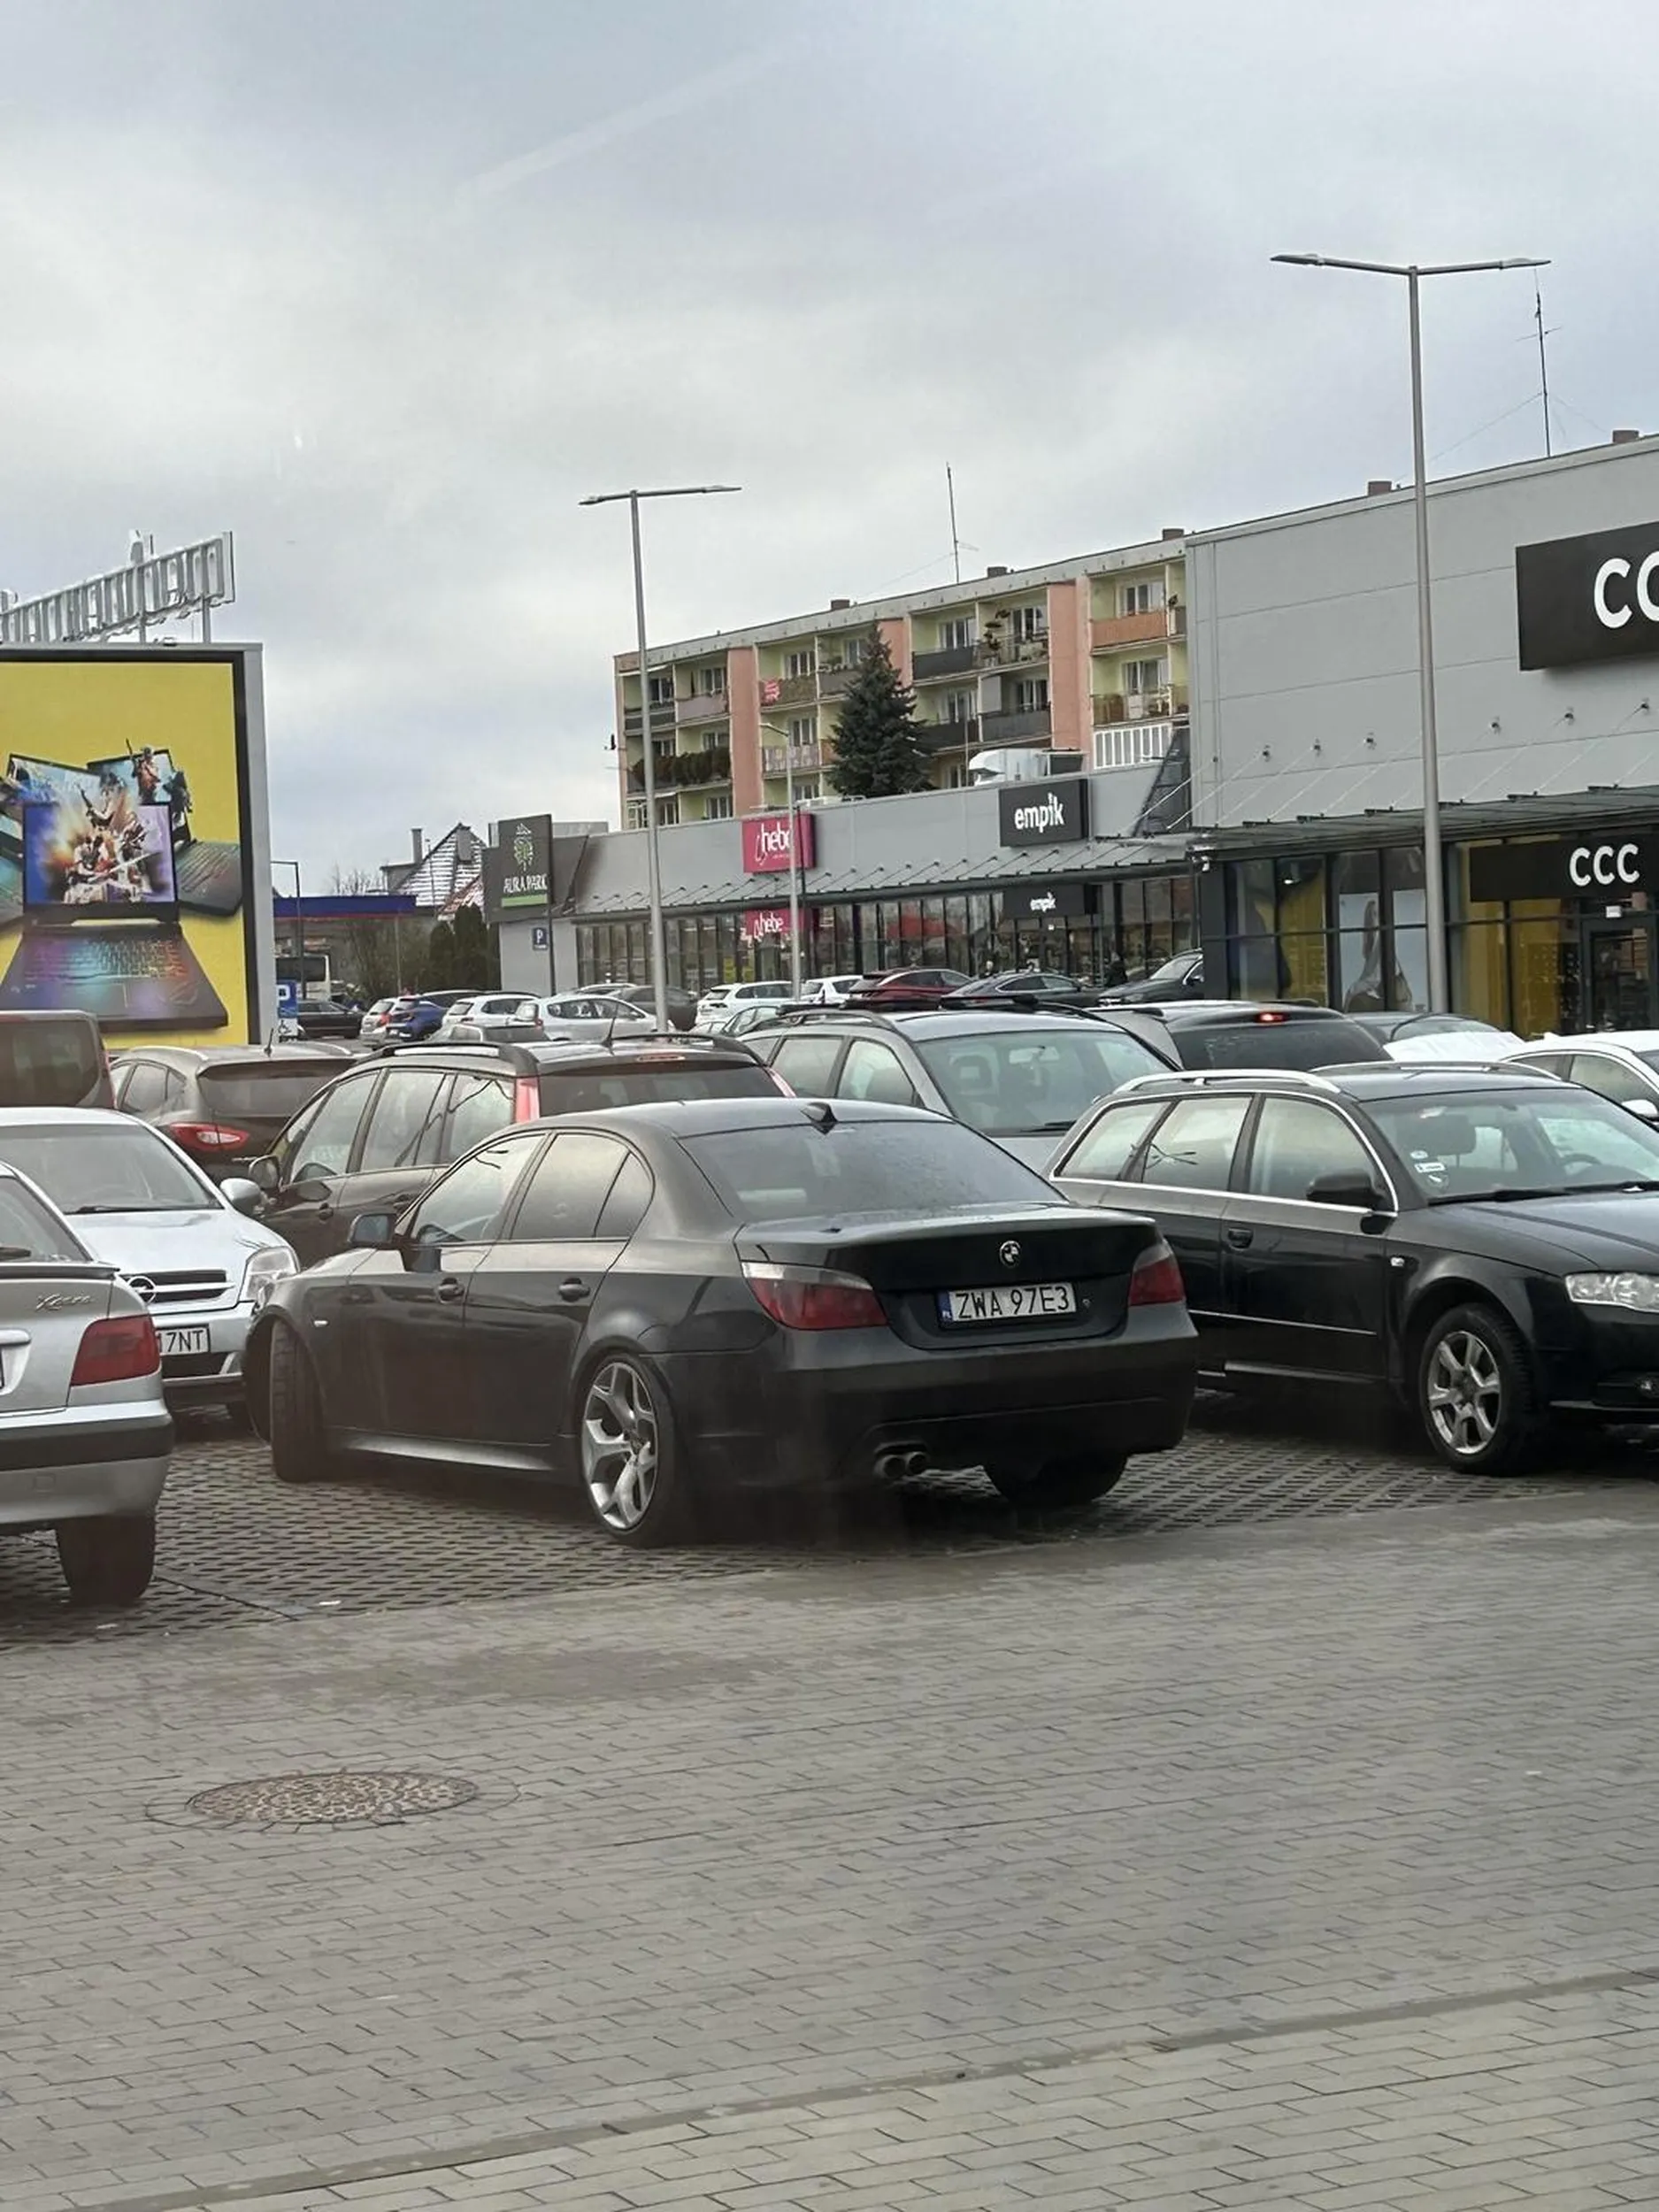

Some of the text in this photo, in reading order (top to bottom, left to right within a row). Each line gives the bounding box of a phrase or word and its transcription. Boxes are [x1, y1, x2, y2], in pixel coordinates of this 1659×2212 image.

[1014, 792, 1064, 833] empik
[1570, 843, 1640, 887] CCC
[956, 1291, 1002, 1318] ZWA
[1010, 1286, 1069, 1315] 97E3
